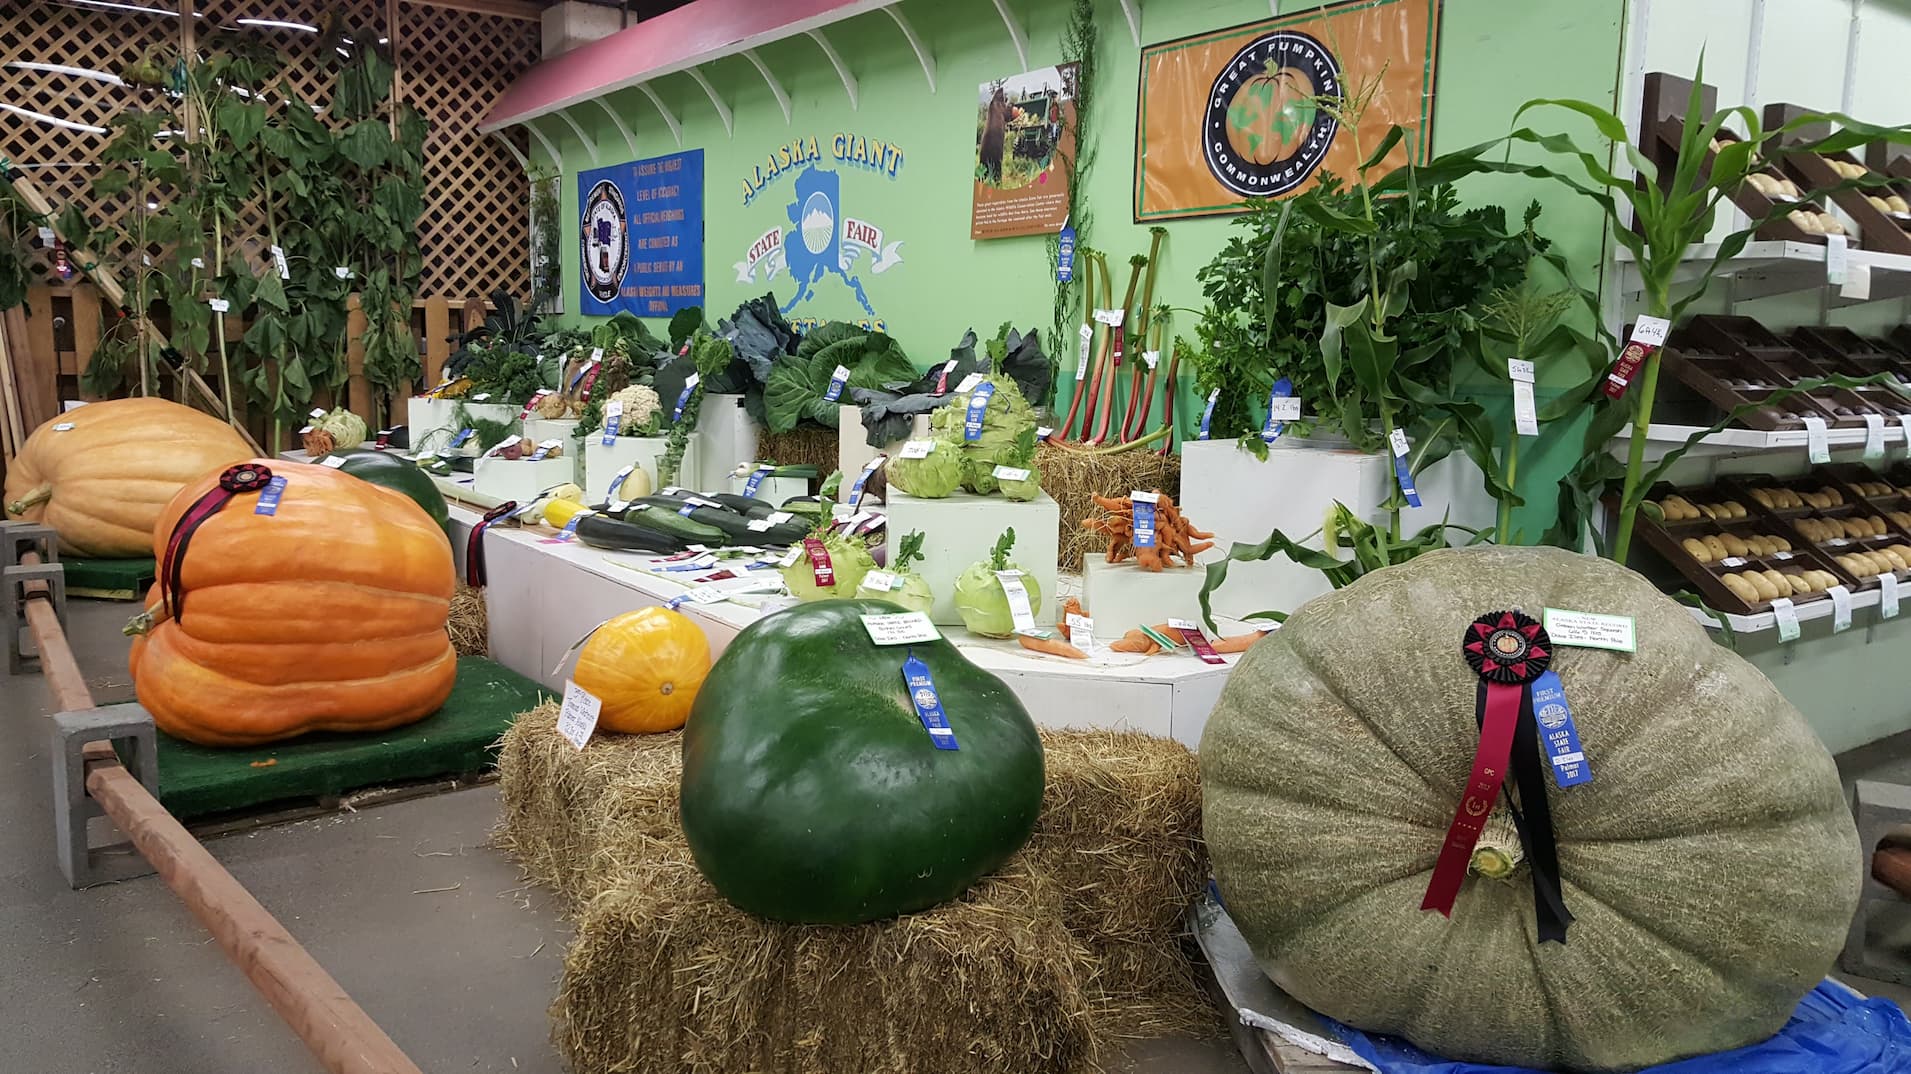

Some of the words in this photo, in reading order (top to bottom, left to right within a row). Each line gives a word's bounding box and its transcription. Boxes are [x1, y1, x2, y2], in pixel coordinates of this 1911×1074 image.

[1214, 51, 1256, 108] GREAT
[1268, 42, 1333, 91] PUMPKIN
[1215, 126, 1328, 186] COMMONWEALTH
[741, 135, 820, 205] ALASKA
[832, 132, 904, 177] GIANT
[847, 220, 878, 249] FAIR
[749, 230, 780, 264] STATE
[1536, 688, 1554, 697] FIRST
[1548, 730, 1570, 741] ALASKA
[1553, 738, 1569, 748] STATE
[1557, 746, 1570, 755] FAIR
[1560, 763, 1579, 772] Palmer
[1566, 769, 1579, 779] 2017
